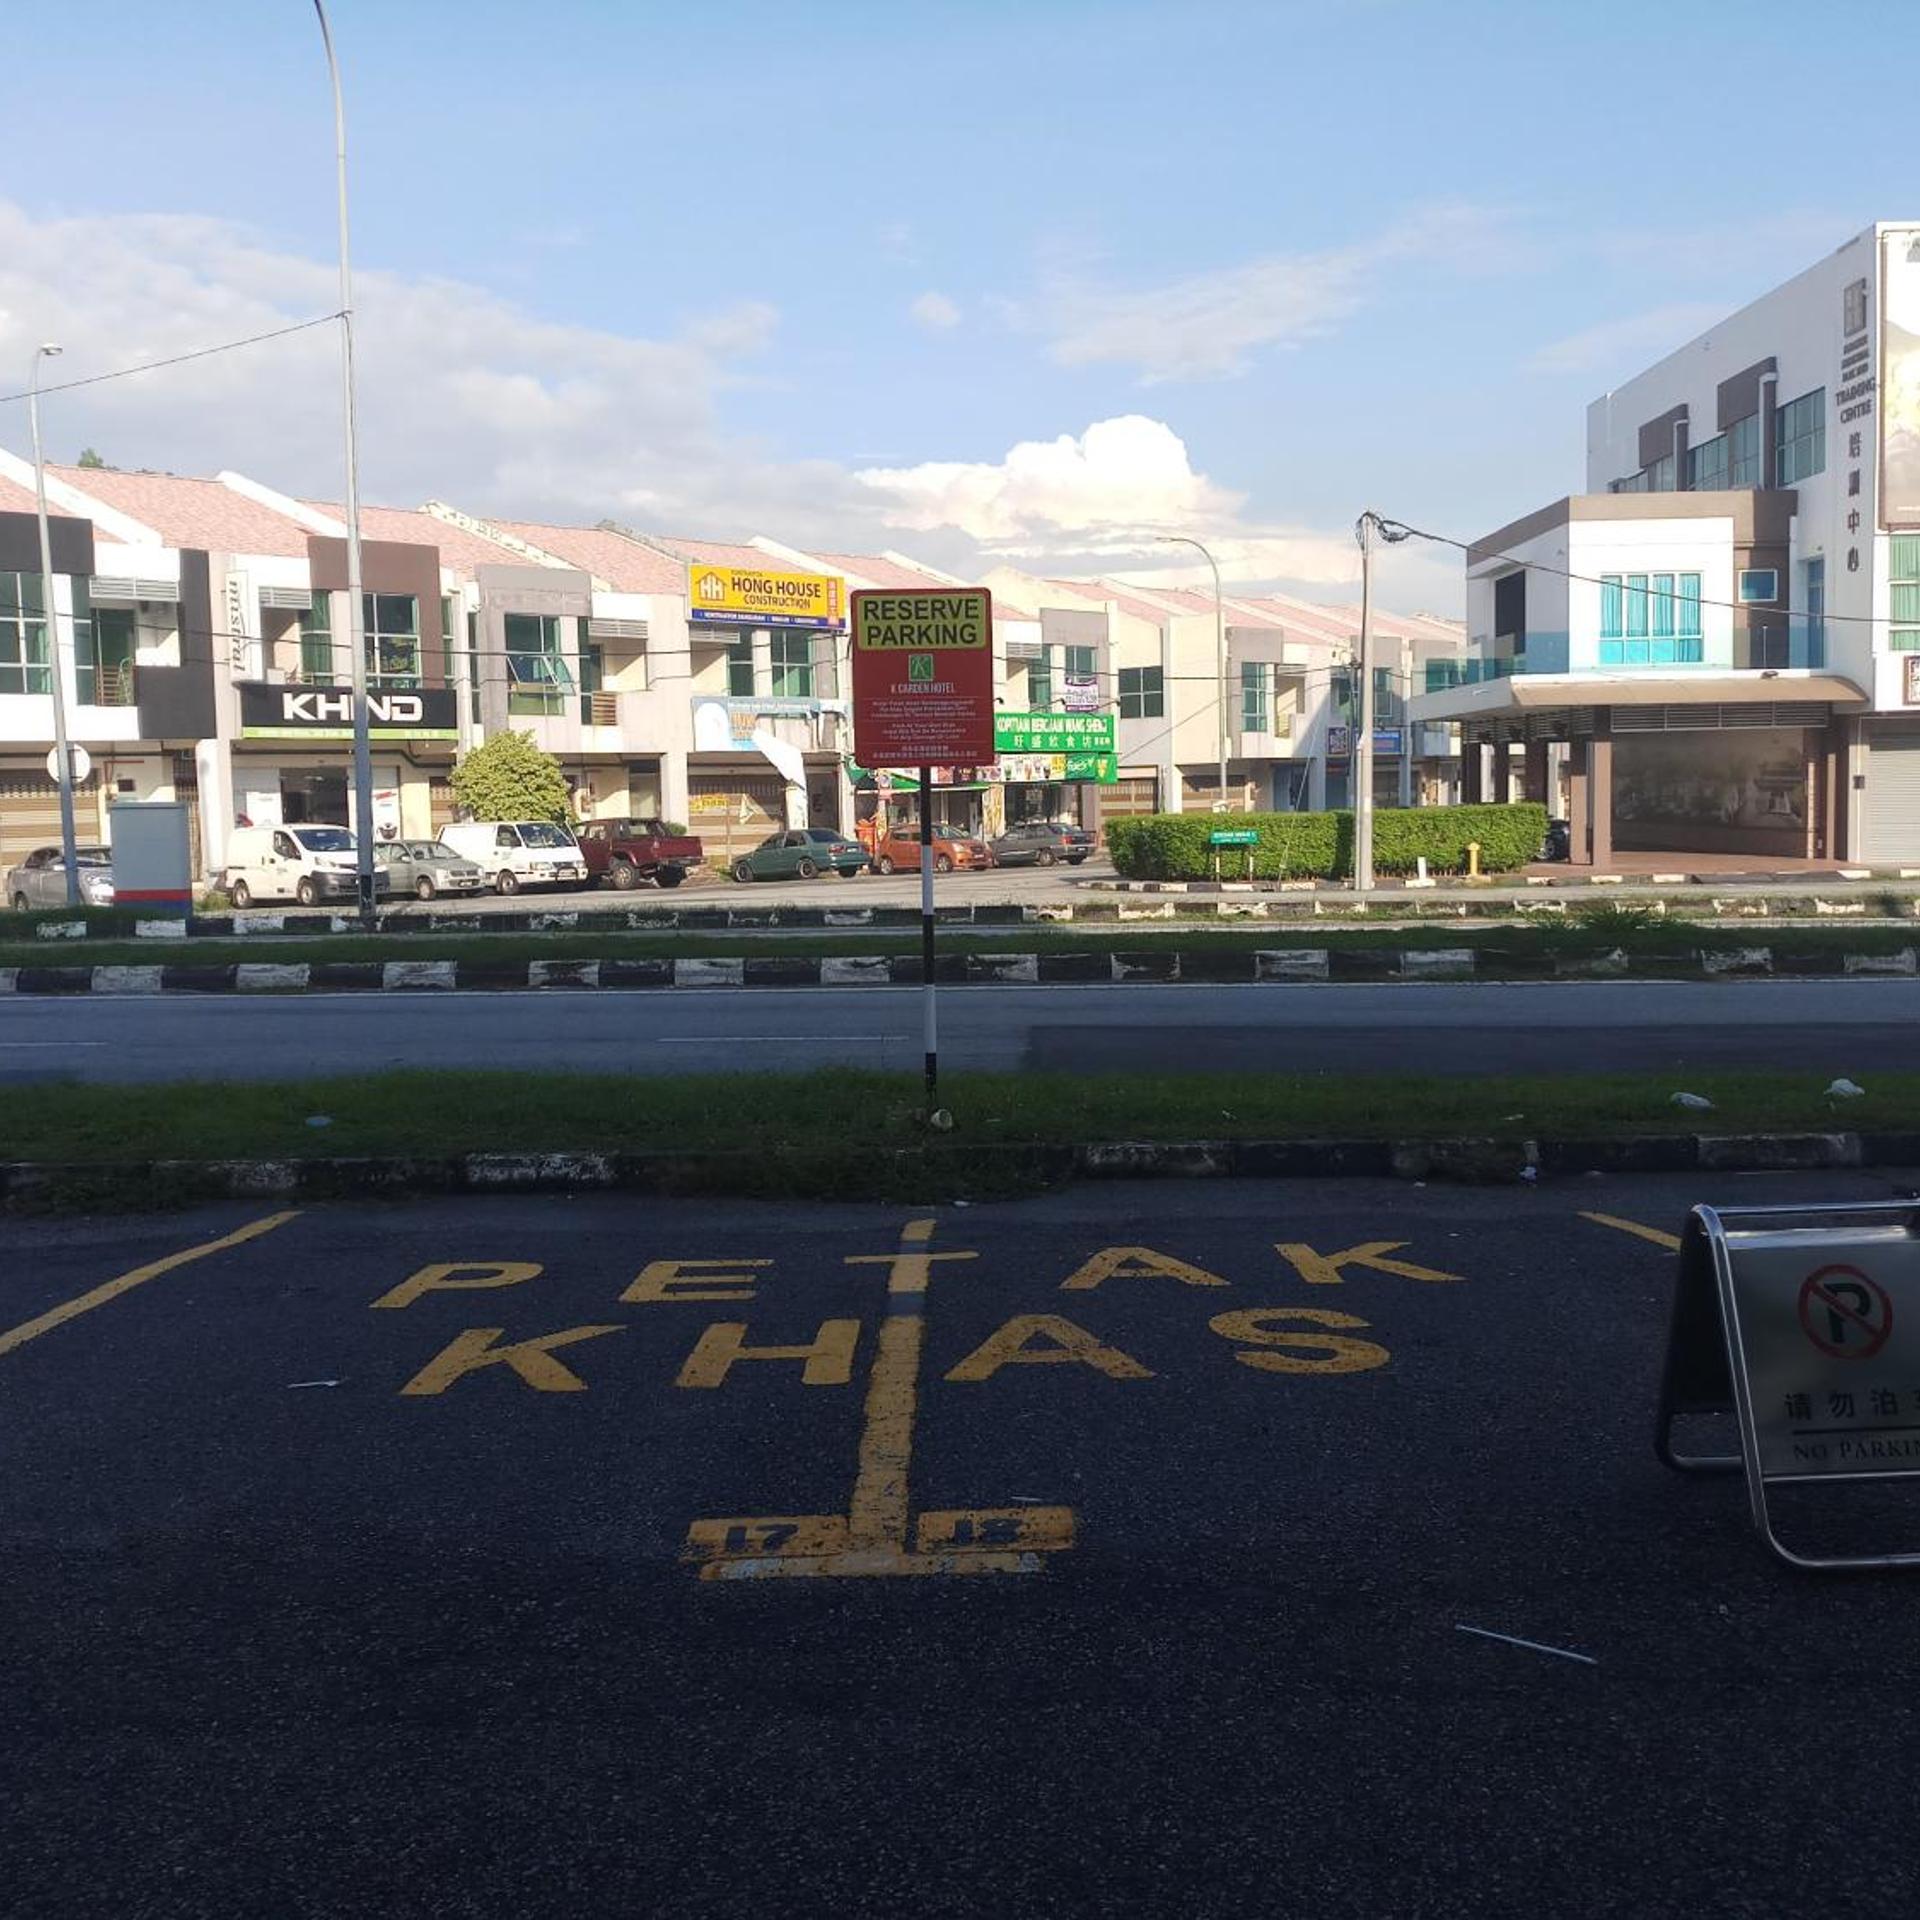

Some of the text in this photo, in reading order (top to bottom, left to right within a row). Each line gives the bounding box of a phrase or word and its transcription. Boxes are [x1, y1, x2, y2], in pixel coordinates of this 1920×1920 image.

[731, 577, 821, 598] HONG HOUSE
[744, 594, 810, 609] CONSTRUCTION
[864, 599, 980, 621] RESERVE
[866, 623, 978, 647] PARKING
[931, 682, 955, 693] HOTEL
[401, 1310, 1392, 1396] KHAS
[1784, 1388, 1920, 1420] 请勿泊
[1793, 1444, 1828, 1461] NO
[725, 1522, 801, 1553] 17
